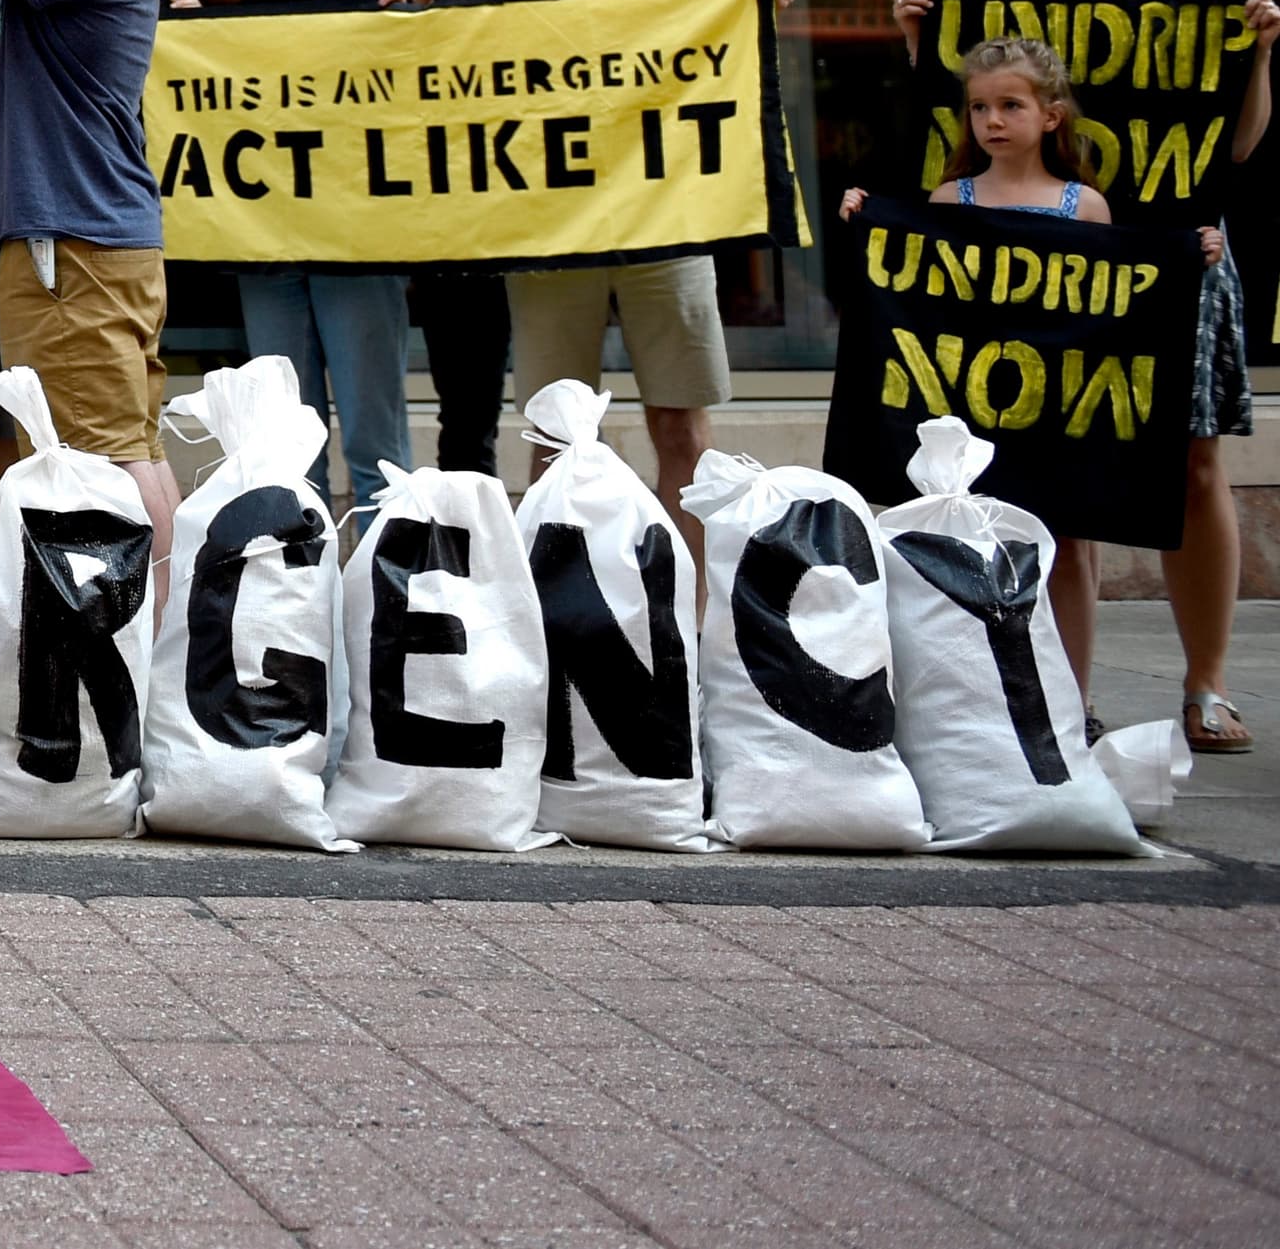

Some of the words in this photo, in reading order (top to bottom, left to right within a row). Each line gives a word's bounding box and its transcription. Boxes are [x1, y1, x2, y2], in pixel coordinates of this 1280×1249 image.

[167, 78, 261, 112] THIS
[281, 74, 317, 108] IS
[333, 68, 394, 105] AN
[418, 43, 730, 101] EMERGENCY
[938, 0, 1258, 92] UNDRIP
[161, 129, 323, 200] ACT
[368, 115, 596, 197] LIKE
[642, 100, 738, 180] IT
[867, 227, 1159, 317] UNDRIP
[881, 328, 1156, 441] NOW
